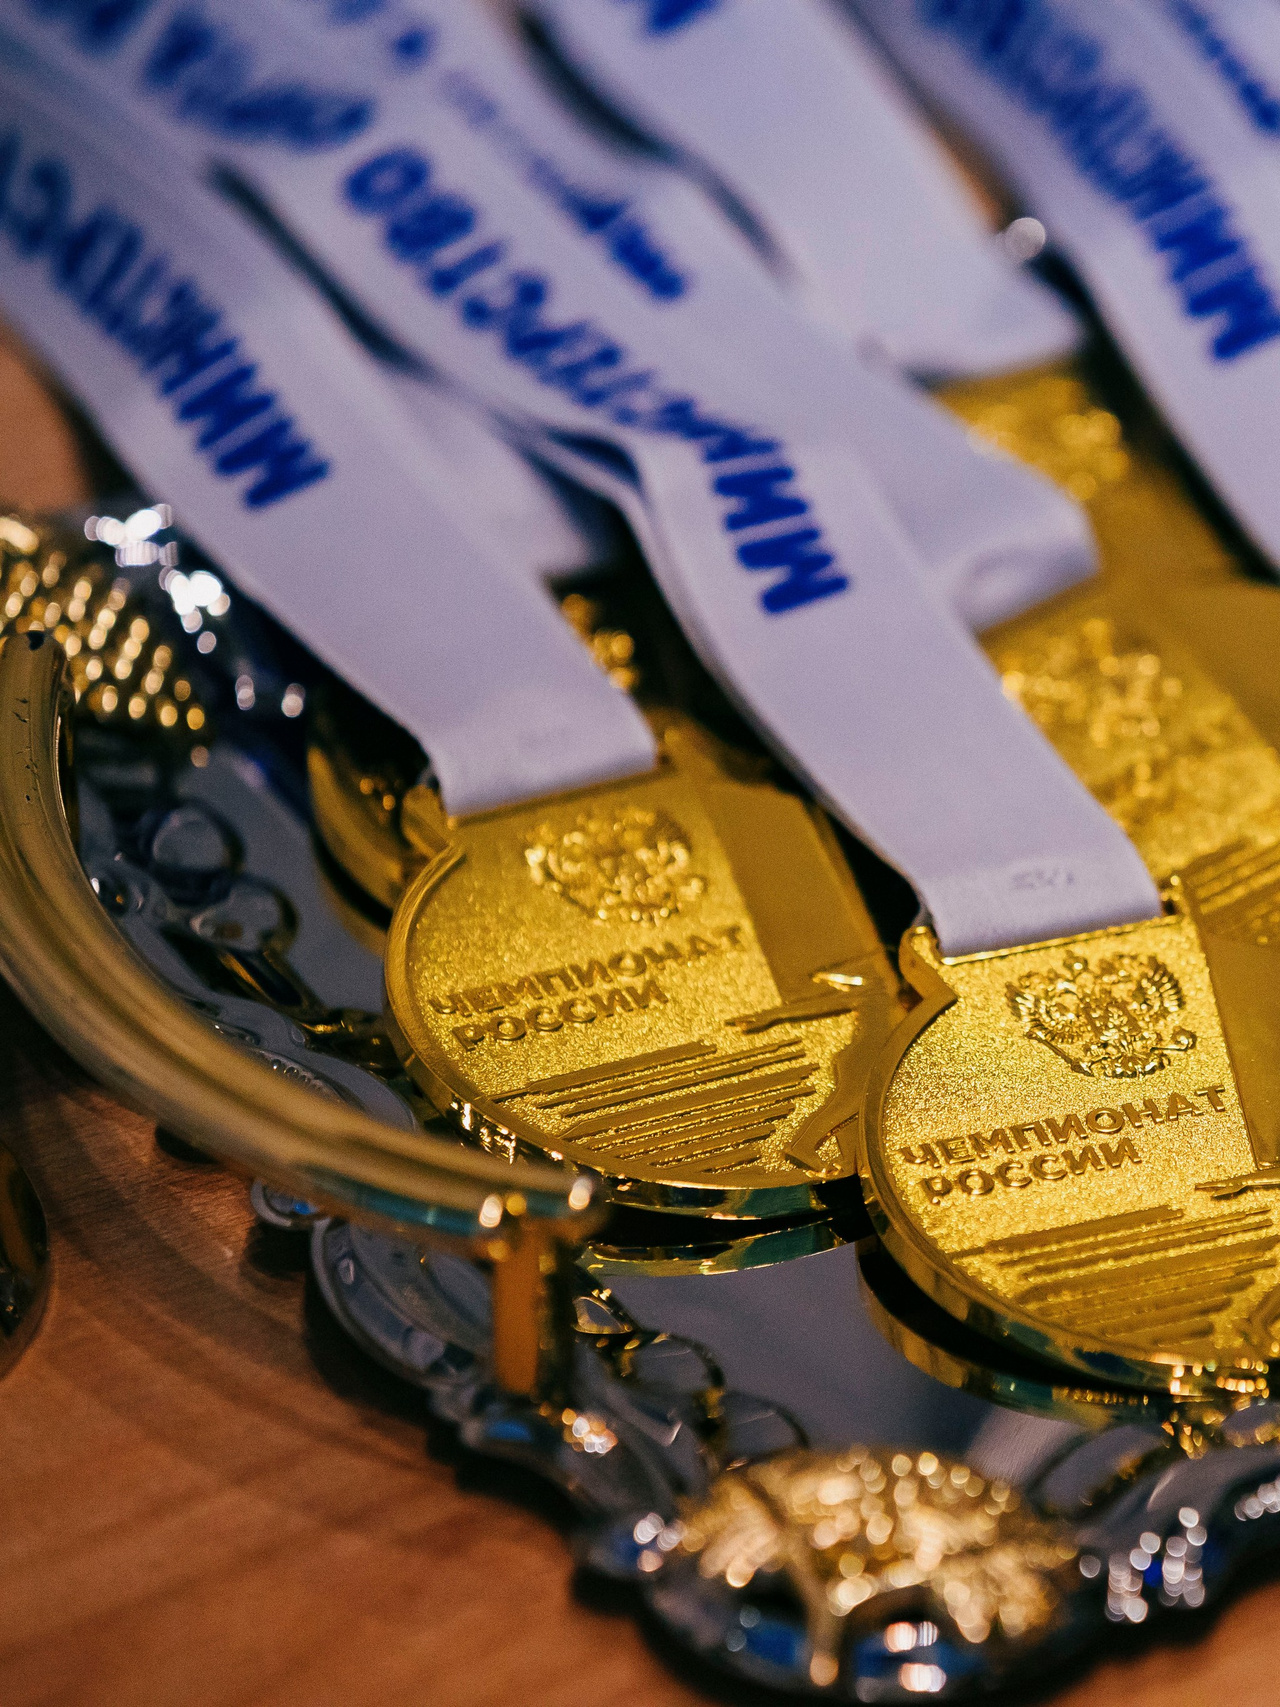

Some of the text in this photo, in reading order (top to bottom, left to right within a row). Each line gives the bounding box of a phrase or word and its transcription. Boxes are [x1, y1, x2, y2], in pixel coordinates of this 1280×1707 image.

[428, 925, 743, 1018] ЧЕМПИОНАТ
[451, 980, 670, 1051] РОССИИ
[902, 1084, 1227, 1168] ЧЕМПИОНАТ
[920, 1137, 1142, 1204] РОССИИ
